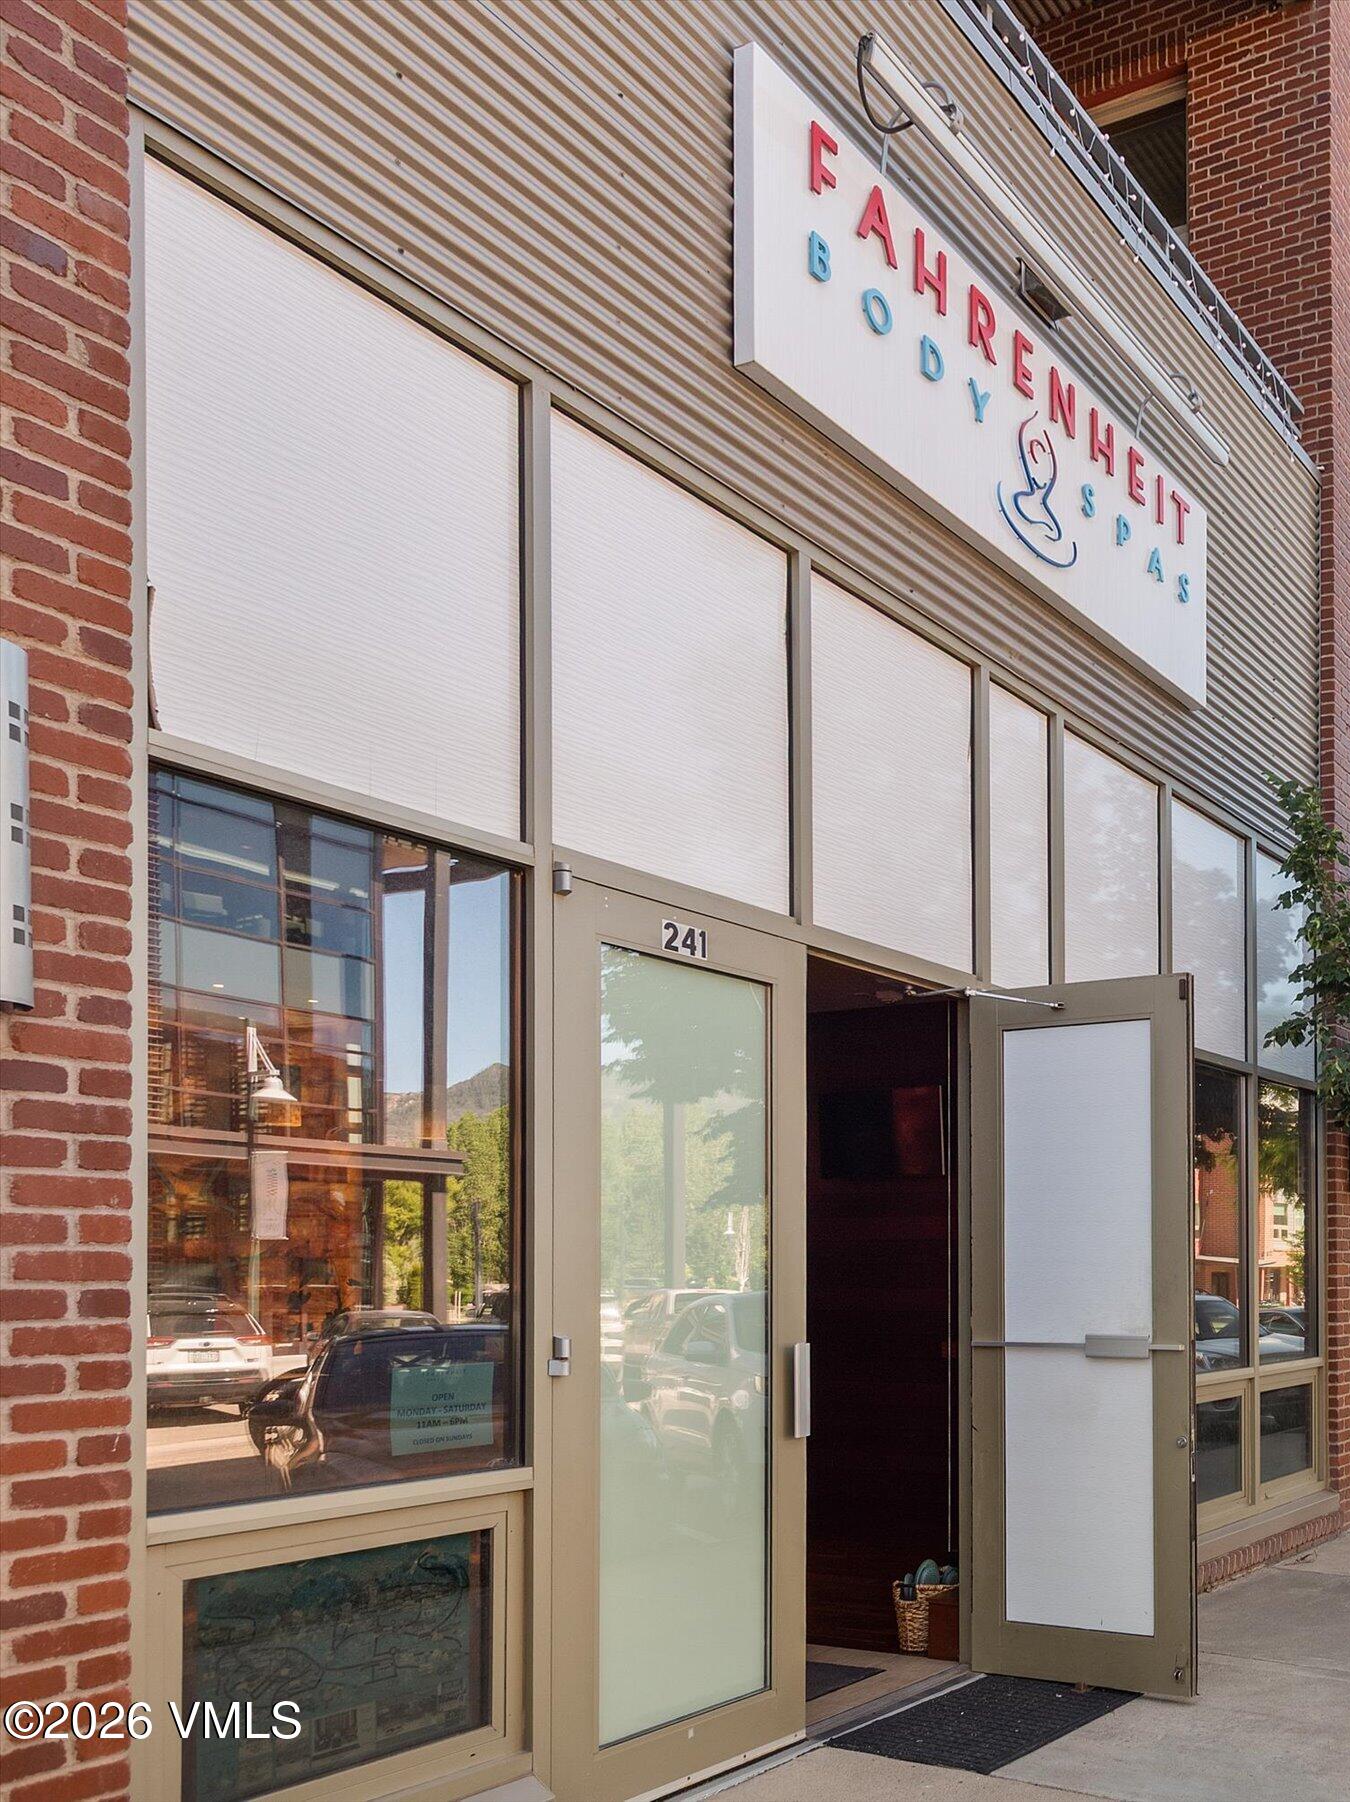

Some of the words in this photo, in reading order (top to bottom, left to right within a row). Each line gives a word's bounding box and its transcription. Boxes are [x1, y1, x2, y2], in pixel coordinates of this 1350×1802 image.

[809, 119, 1191, 545] FAHRENHEIT
[808, 229, 991, 424] BODY
[1080, 482, 1190, 604] SPAS
[663, 921, 707, 959] 241
[396, 1406, 436, 1418] MONDAY
[443, 1402, 487, 1415] SATURDAY
[431, 1392, 455, 1402] OPEN
